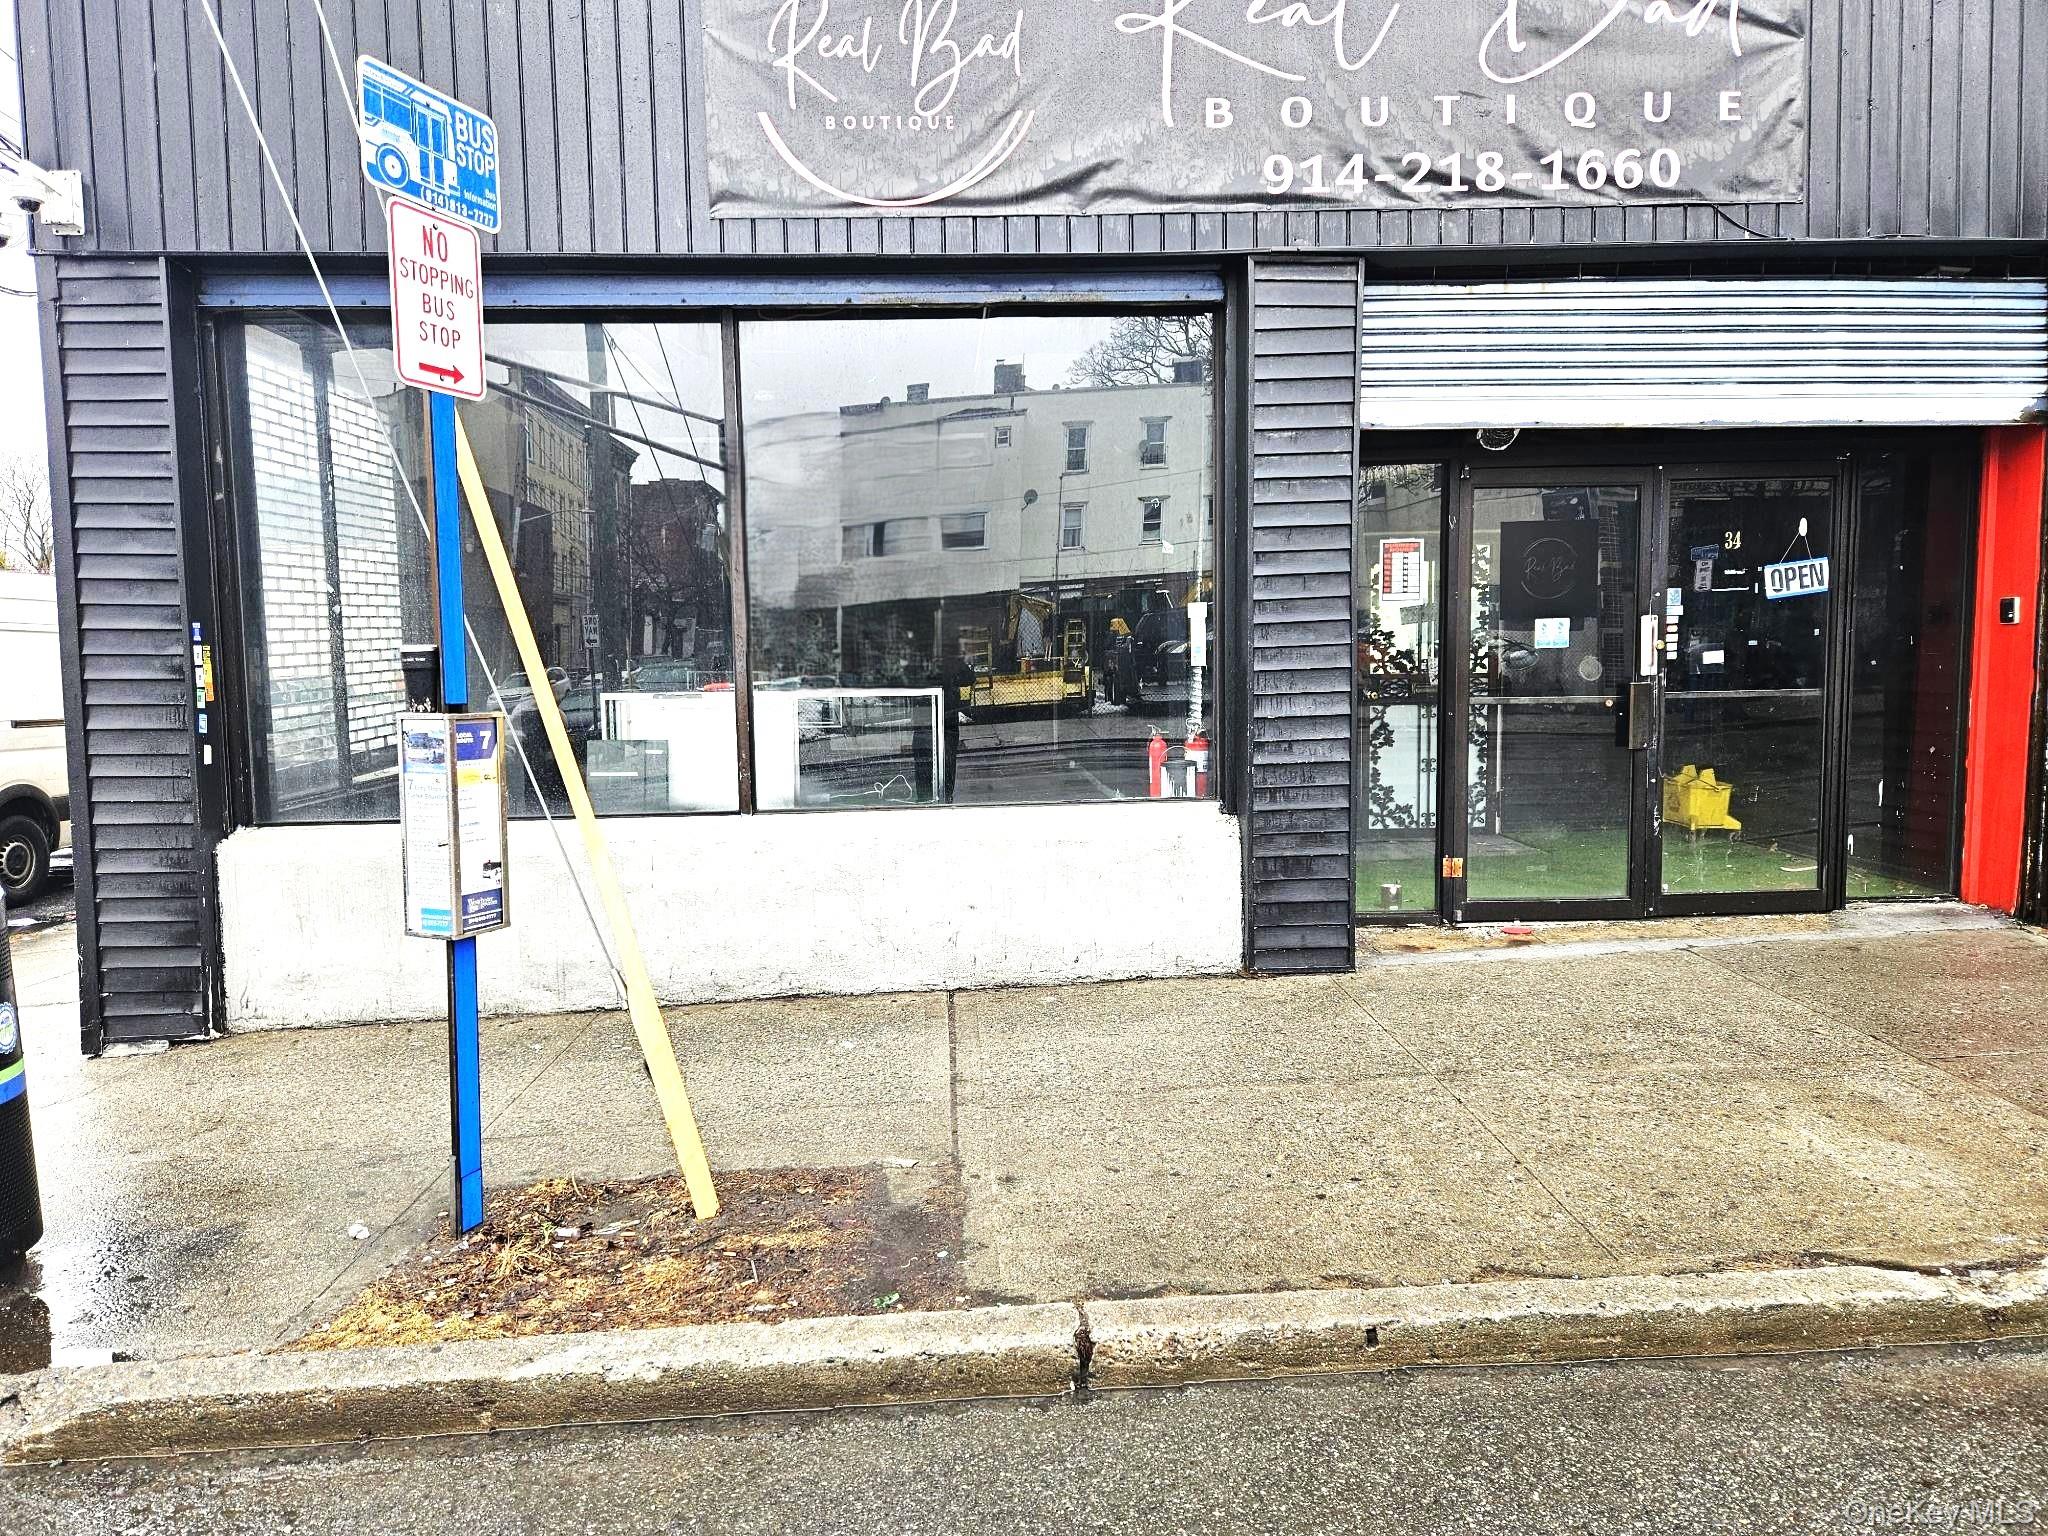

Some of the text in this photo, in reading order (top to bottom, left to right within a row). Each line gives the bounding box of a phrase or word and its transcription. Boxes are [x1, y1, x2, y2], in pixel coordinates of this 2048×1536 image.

[768, 0, 1024, 116] Real Bad
[825, 114, 954, 130] BOUTIQUE
[1206, 92, 1742, 128] BOUTIQUE
[455, 111, 494, 155] BUS
[457, 142, 495, 178] STOP
[1264, 149, 1681, 196] 914-218-1660
[422, 225, 449, 262] NO
[400, 257, 474, 299] STOPPING
[422, 293, 455, 320] BUS
[419, 321, 461, 349] STOP
[1724, 531, 1742, 550] 34
[1770, 562, 1825, 592] OPEN
[479, 730, 492, 750] 7
